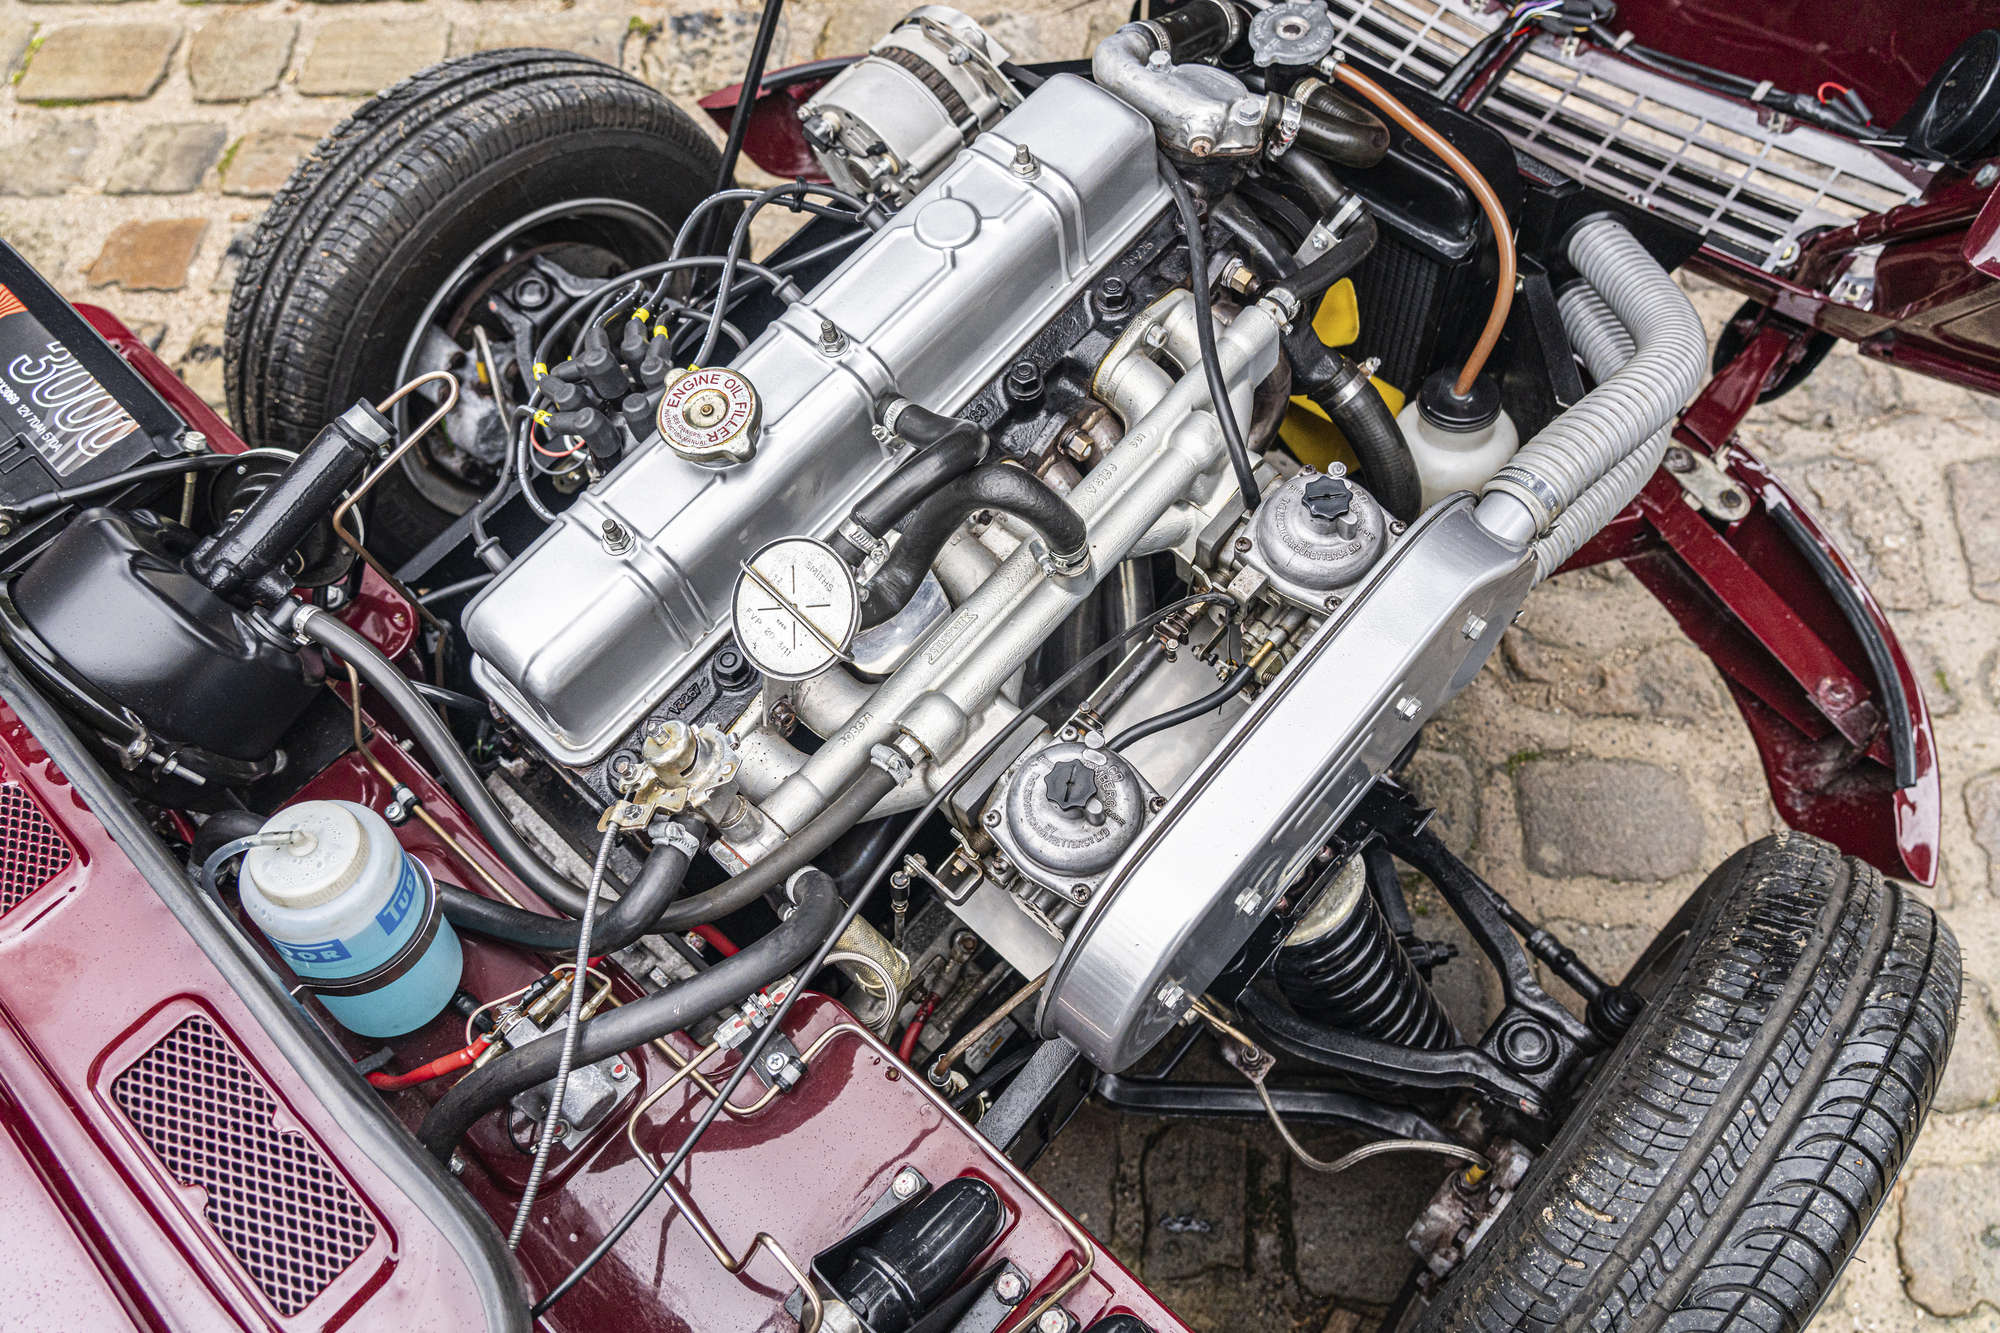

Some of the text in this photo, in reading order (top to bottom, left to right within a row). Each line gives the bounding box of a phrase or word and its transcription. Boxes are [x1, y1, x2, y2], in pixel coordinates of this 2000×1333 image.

[17, 404, 34, 418] 12V
[41, 432, 63, 452] 570A
[667, 374, 747, 443] ENGINE OIL FILLER
[805, 560, 834, 592] SMITHS
